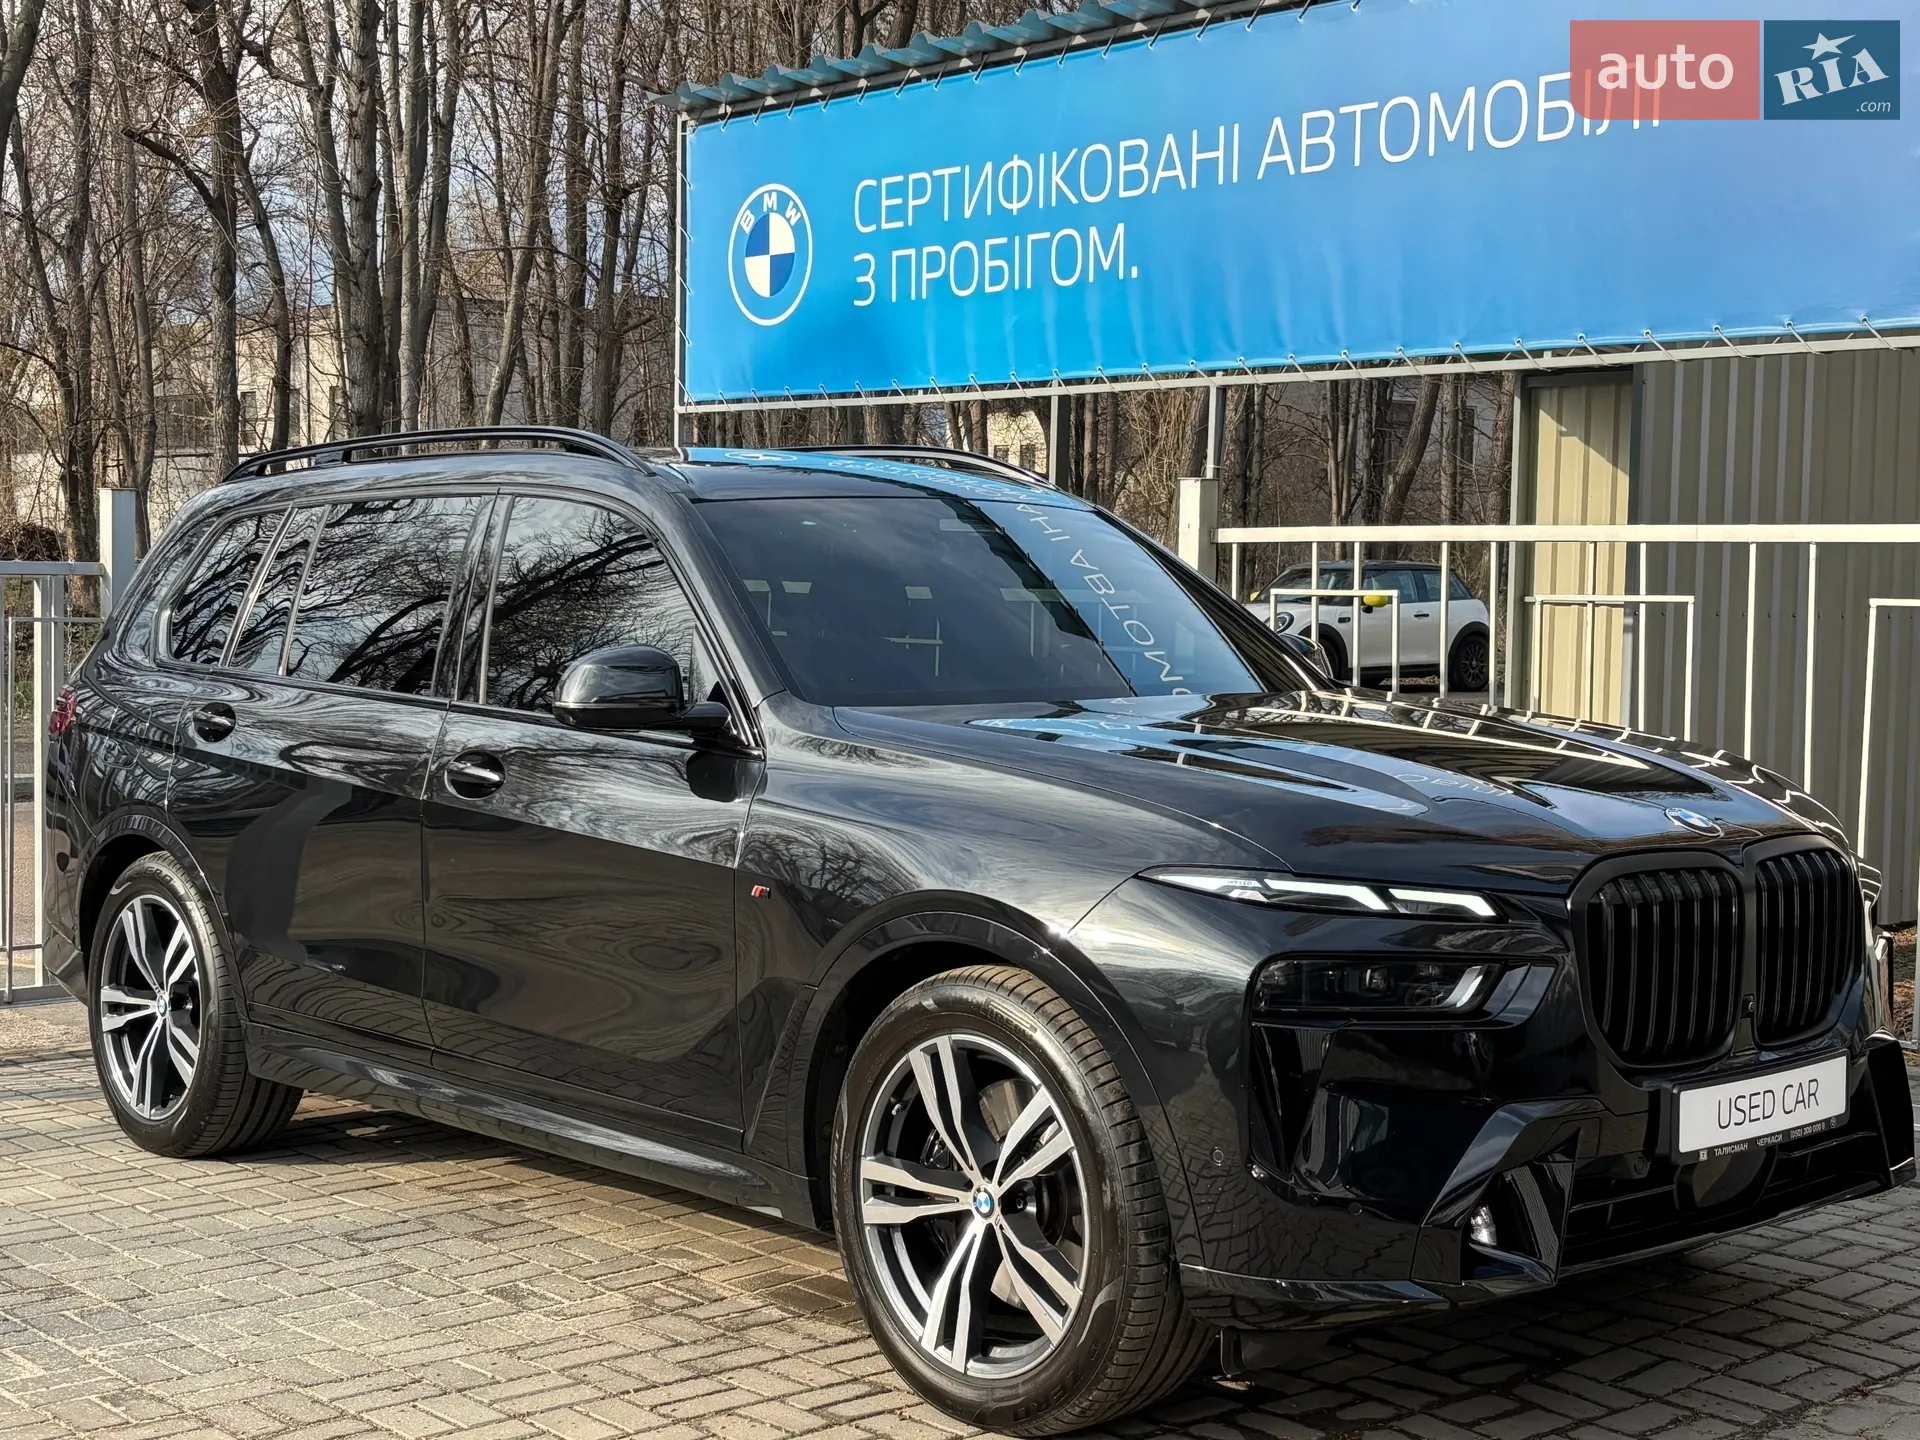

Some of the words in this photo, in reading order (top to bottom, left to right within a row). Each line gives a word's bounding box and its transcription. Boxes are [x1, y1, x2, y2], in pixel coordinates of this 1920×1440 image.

[855, 124, 1239, 233] СЕРТИФІКОВАНІ
[1258, 58, 1661, 180] АВТОМОБІЛІ
[739, 191, 802, 235] BMW
[893, 223, 1138, 302] ПРОБІГОМ.
[1718, 1090, 1776, 1130] USED
[1783, 1078, 1819, 1115] CAR
[1714, 1142, 1749, 1157] ТАЛИСМАН
[1757, 1133, 1783, 1147] ЧЕРКАСИ
